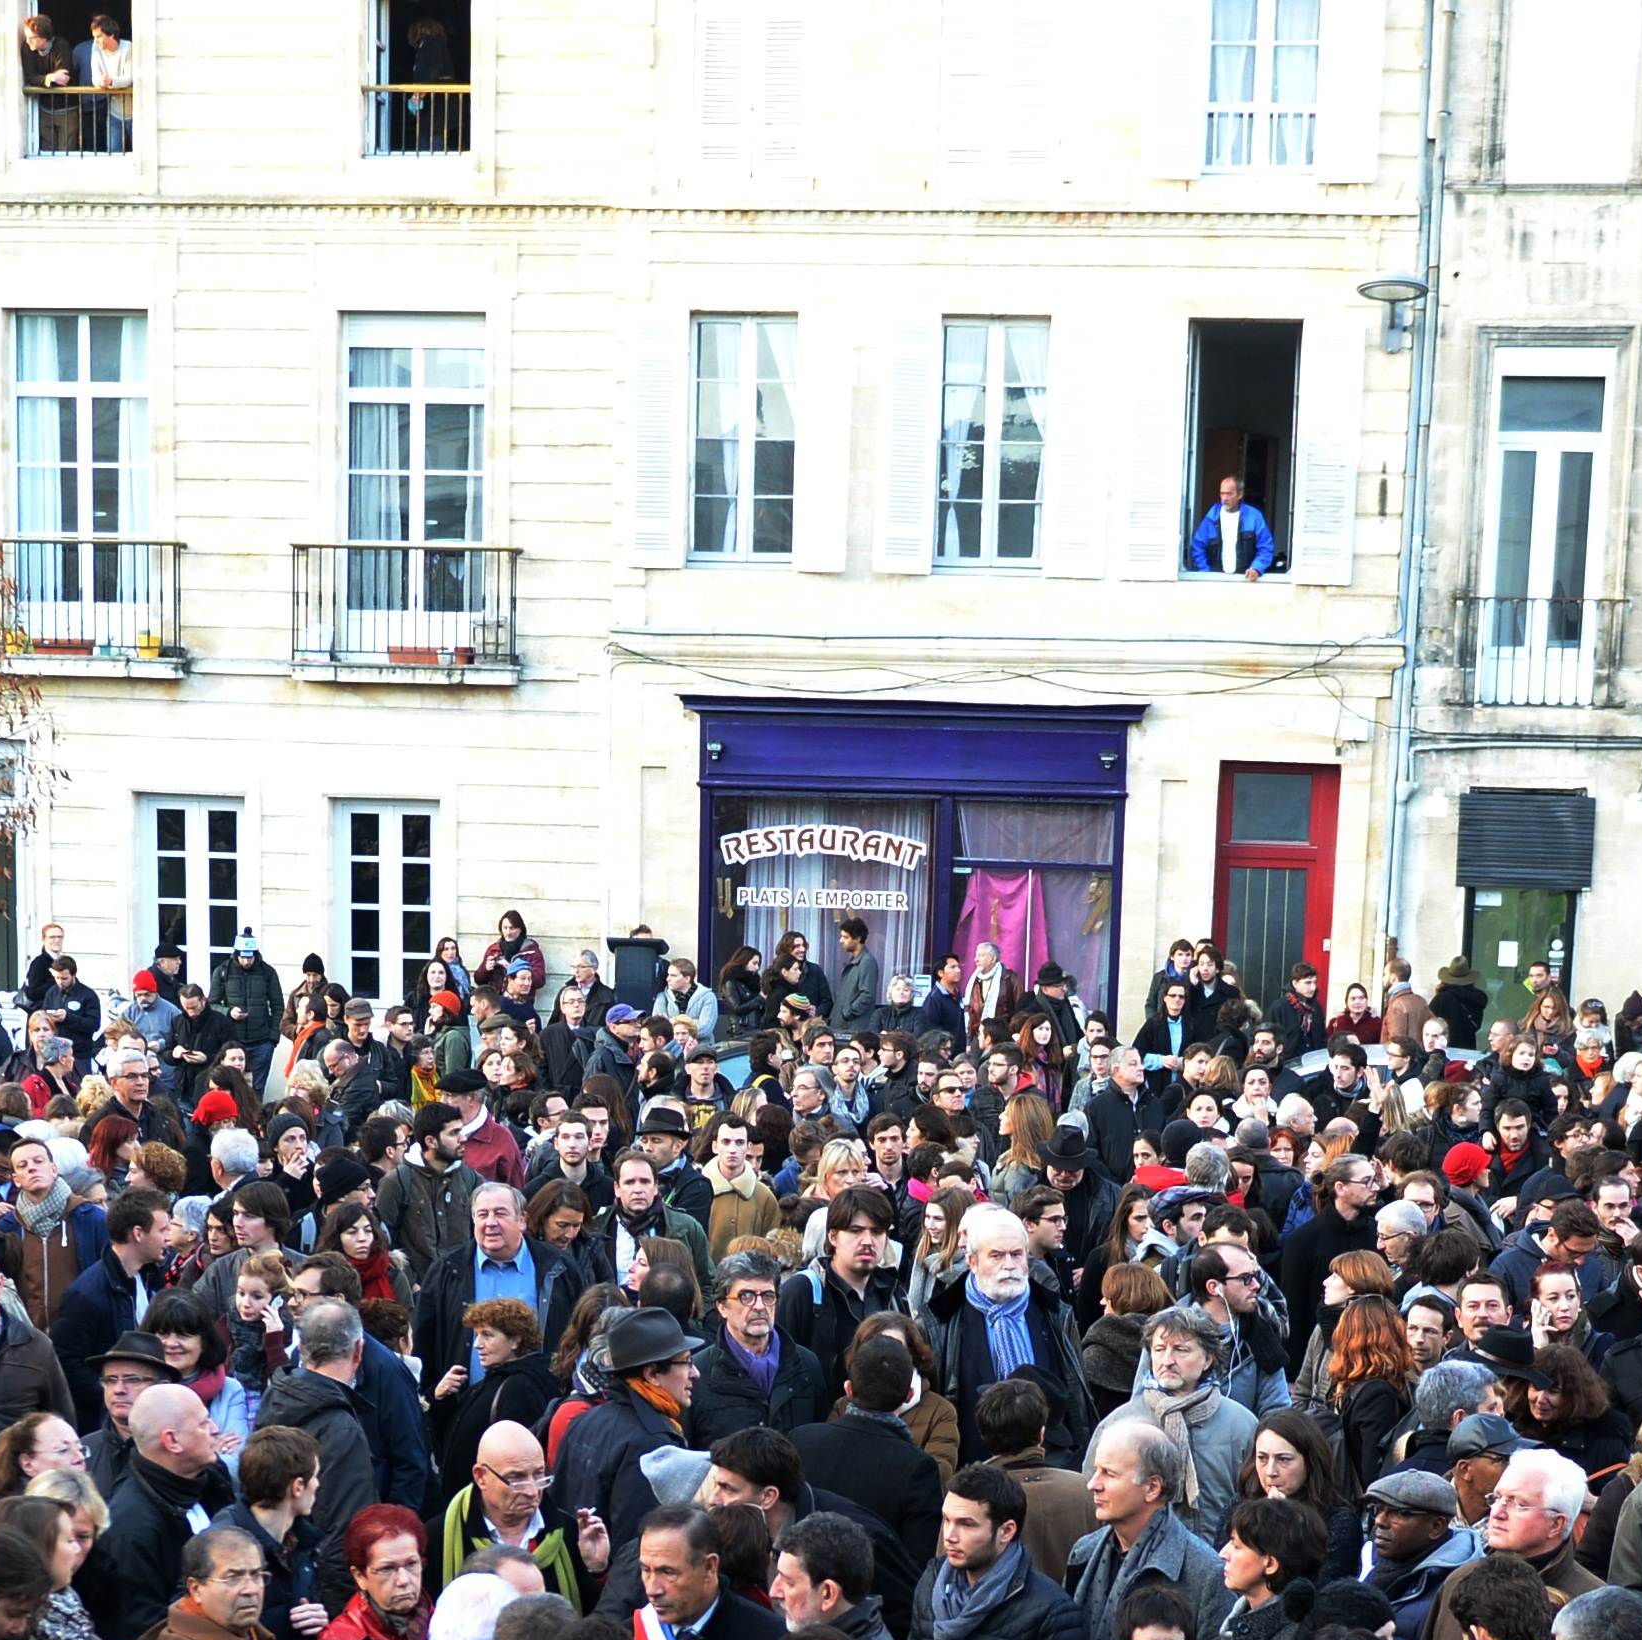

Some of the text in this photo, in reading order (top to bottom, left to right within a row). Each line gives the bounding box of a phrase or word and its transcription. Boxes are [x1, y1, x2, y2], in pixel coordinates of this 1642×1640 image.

[722, 826, 925, 869] RESTAURANT
[739, 889, 906, 908] PLATS A EMPORTER
